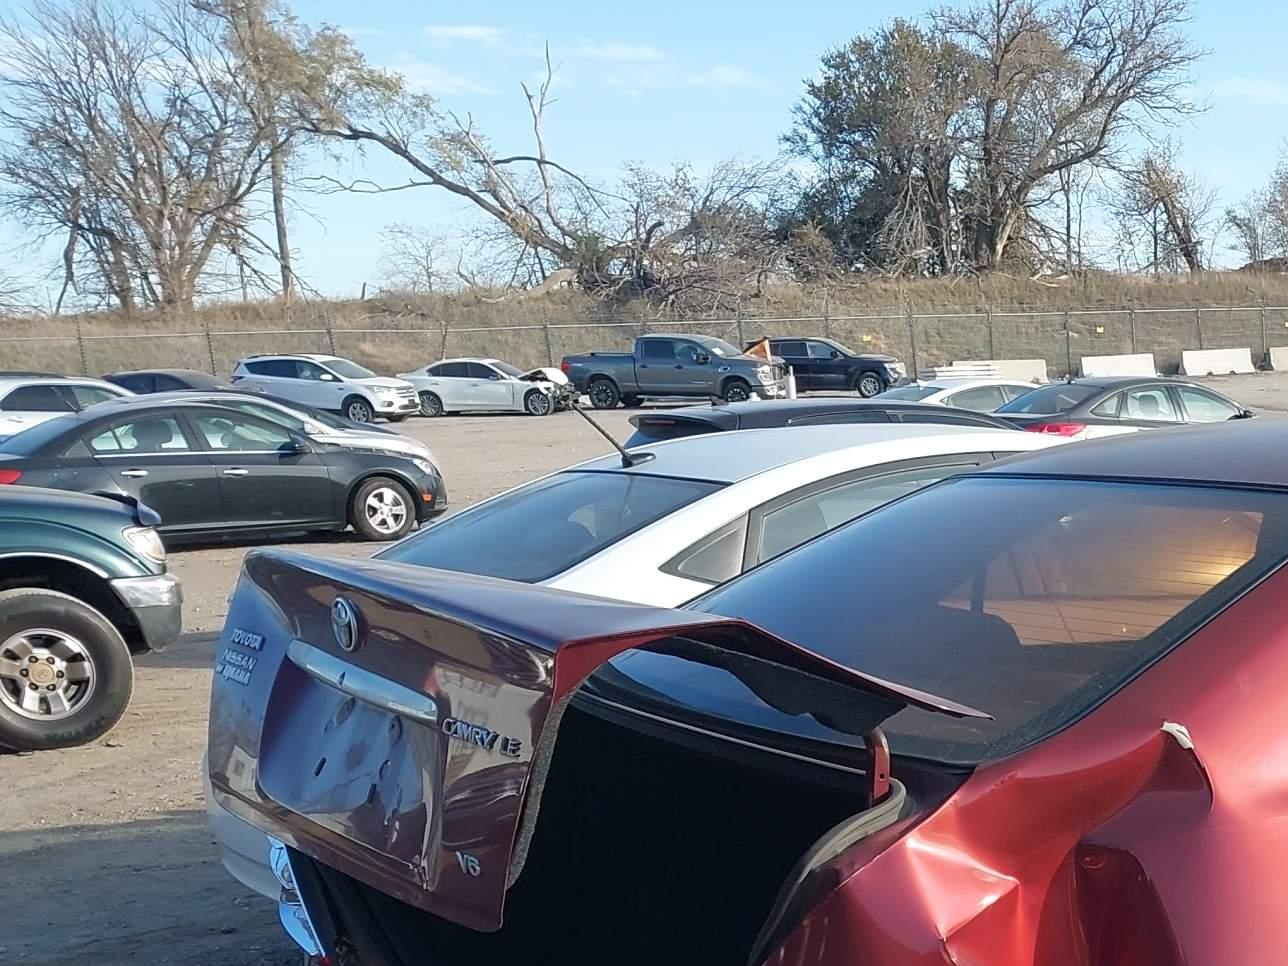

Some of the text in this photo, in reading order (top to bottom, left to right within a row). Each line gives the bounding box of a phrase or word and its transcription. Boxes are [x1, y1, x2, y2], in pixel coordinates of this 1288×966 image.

[229, 627, 263, 650] TOYOTA
[442, 718, 499, 751] CAMRY
[455, 851, 481, 878] V6
